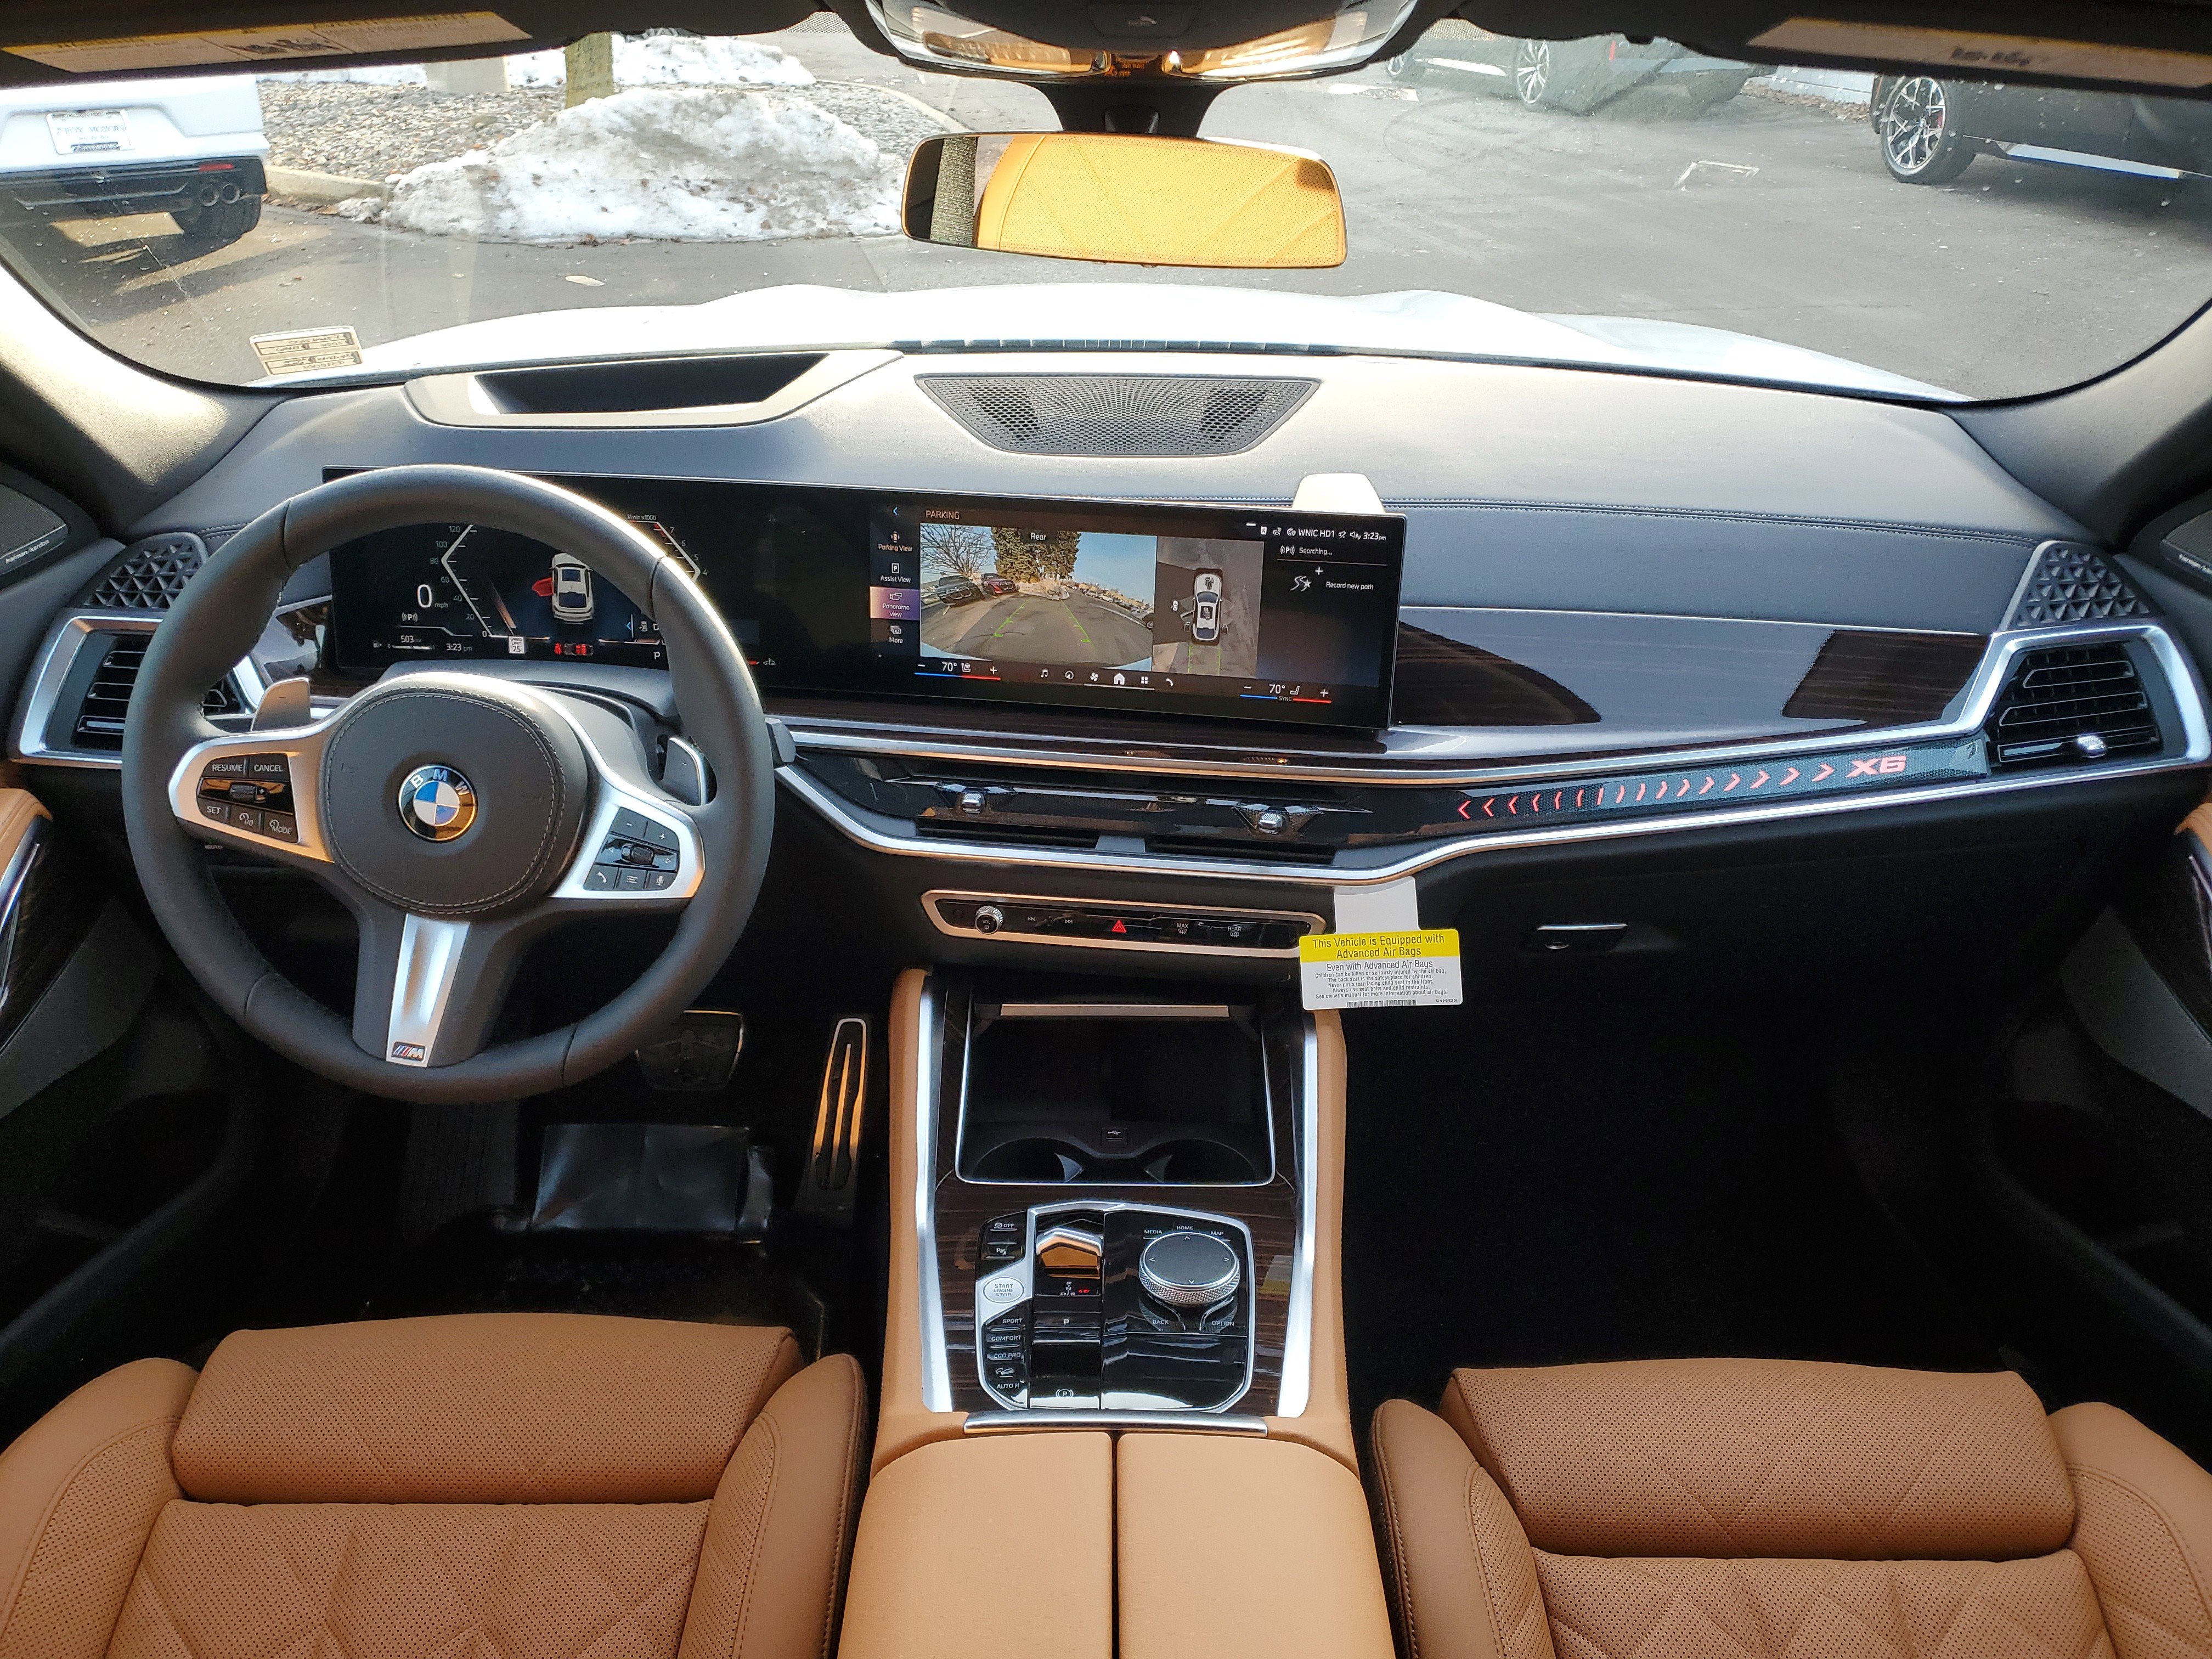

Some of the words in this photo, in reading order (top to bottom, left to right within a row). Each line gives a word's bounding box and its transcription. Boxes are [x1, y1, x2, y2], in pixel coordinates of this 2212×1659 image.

[926, 510, 960, 520] PARKING
[1030, 532, 1047, 540] Rear
[1298, 528, 1319, 537] WNIC
[1319, 529, 1335, 538] HD1
[878, 544, 899, 552] Parking
[1326, 581, 1346, 589] Record
[417, 584, 432, 608] 0
[400, 635, 414, 643] 503
[446, 643, 462, 651] 3:23
[654, 651, 661, 660] P
[212, 764, 244, 772] RESUME
[1845, 755, 1906, 778] X6
[410, 769, 470, 796] BMW
[206, 805, 222, 815] SET
[272, 825, 292, 834] MODE
[1312, 939, 1331, 949] This
[1334, 937, 1367, 947] Vehicle
[1369, 936, 1377, 945] is
[1380, 934, 1422, 947] Equipped
[1425, 933, 1444, 944] with
[1337, 947, 1380, 959] Advanced
[1383, 947, 1396, 956] Air
[1399, 946, 1421, 957] Bags
[1327, 963, 1344, 972] Even
[1346, 962, 1362, 970] with
[1364, 960, 1400, 969] Advanced
[1402, 960, 1413, 968] Air
[1414, 960, 1433, 969] Bags
